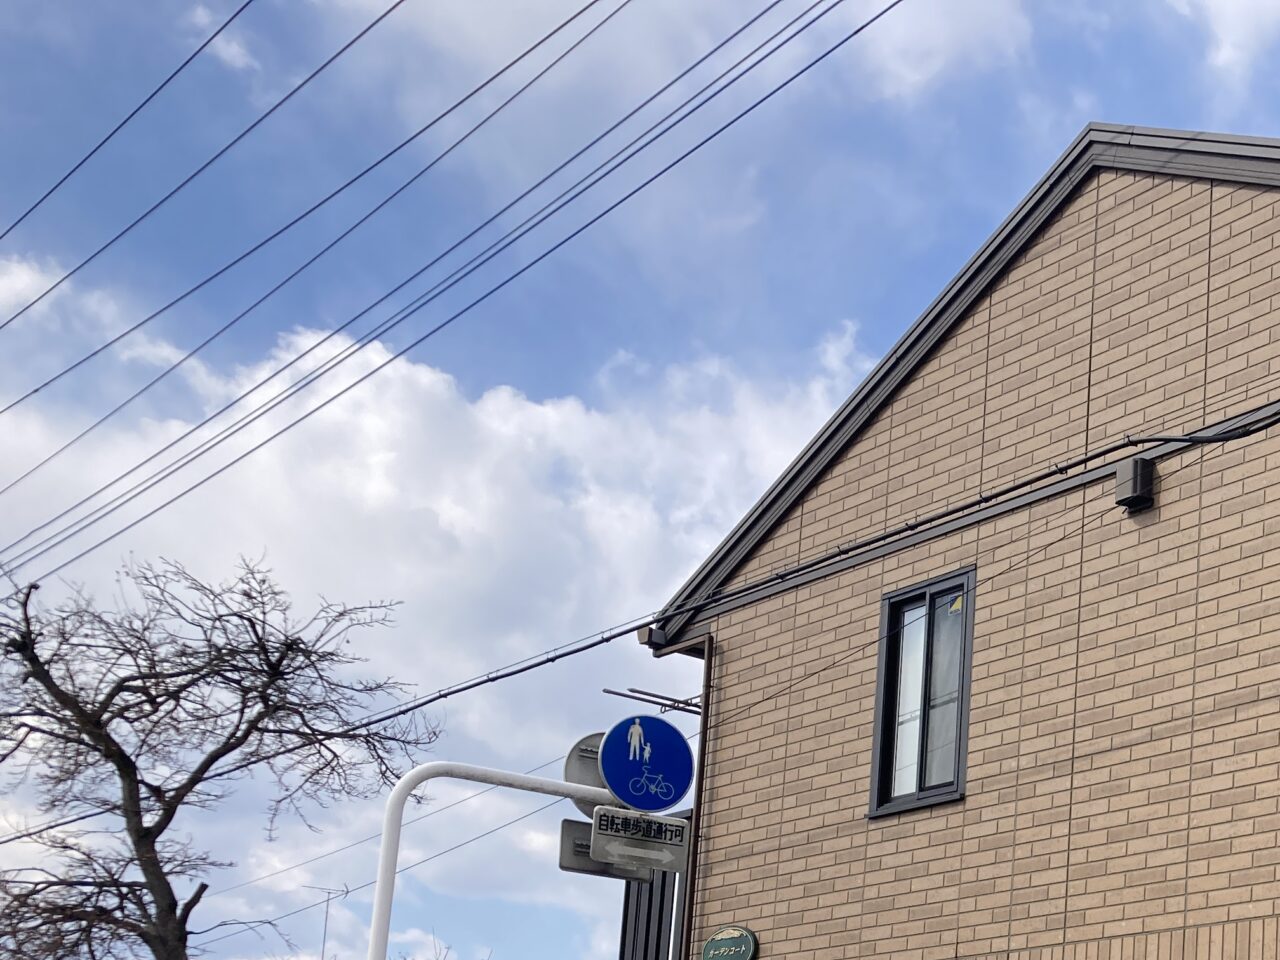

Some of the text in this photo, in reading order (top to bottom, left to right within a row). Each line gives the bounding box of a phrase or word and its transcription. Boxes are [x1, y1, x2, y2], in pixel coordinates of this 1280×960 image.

[598, 813, 686, 843] 自転車歩道通行可
